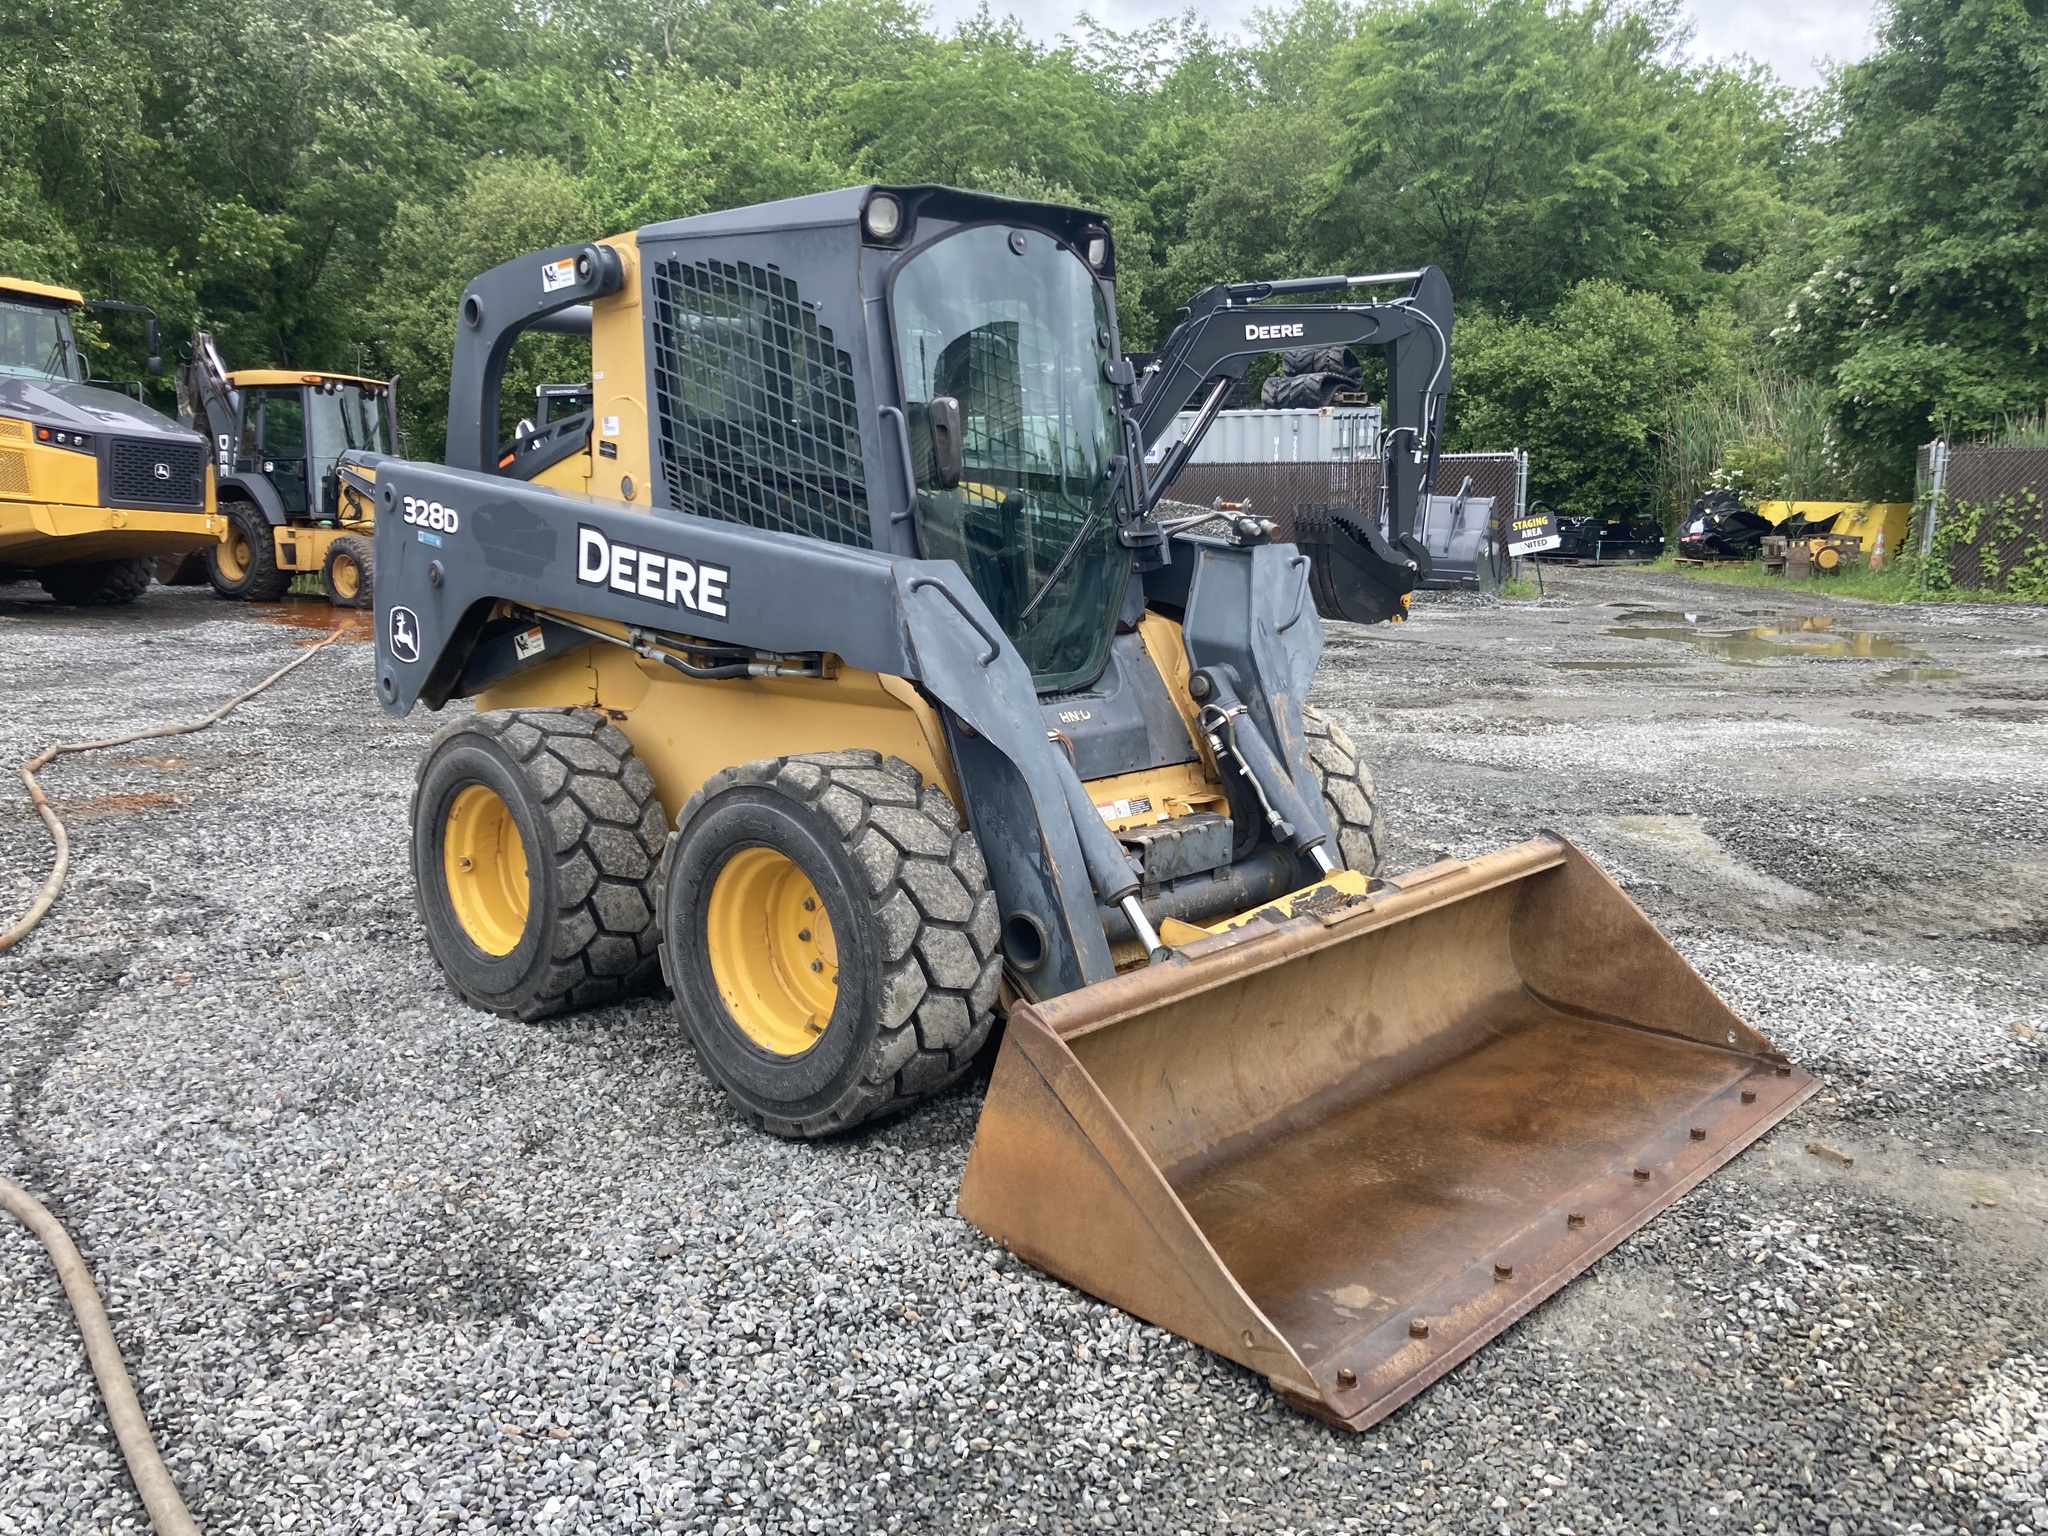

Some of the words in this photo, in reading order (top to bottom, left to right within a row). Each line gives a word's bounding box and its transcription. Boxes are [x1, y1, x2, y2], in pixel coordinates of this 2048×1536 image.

[1245, 323, 1304, 340] DEERE
[218, 434, 229, 477] DEE
[403, 495, 459, 534] 328D
[1512, 516, 1548, 531] STAGING
[1522, 527, 1543, 539] AREA
[577, 525, 729, 619] DEERE
